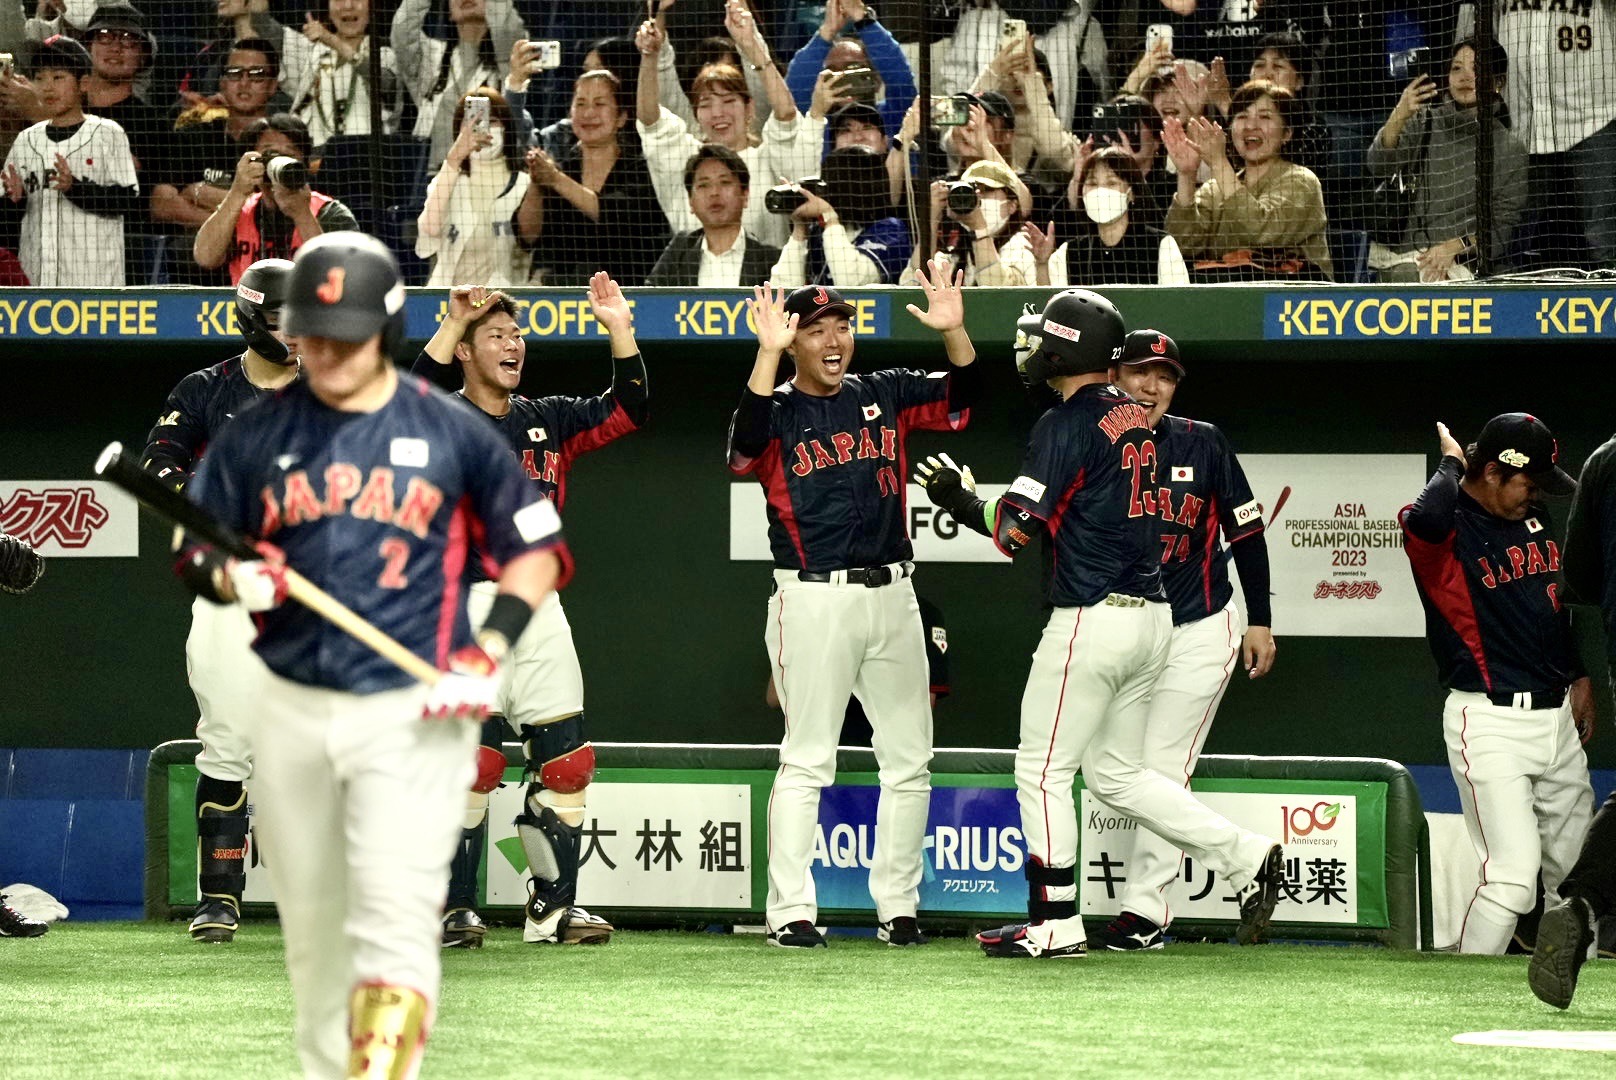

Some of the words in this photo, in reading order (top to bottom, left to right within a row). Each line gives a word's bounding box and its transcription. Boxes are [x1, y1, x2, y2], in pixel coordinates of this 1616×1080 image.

[1557, 24, 1593, 52] 89
[316, 266, 346, 305] J
[813, 286, 830, 306] J
[1150, 335, 1168, 355] J
[791, 425, 897, 478] JAPAN
[1121, 439, 1158, 519] 23
[0, 487, 110, 549] クスト
[1333, 503, 1368, 518] ASIA
[1285, 519, 1361, 531] PROFESSIONAL
[1363, 520, 1404, 531] BASEBA
[1160, 534, 1190, 564] 74
[1331, 550, 1368, 567] 2023
[377, 538, 412, 590] 2
[1314, 580, 1382, 599] カーネクスト
[1280, 801, 1337, 845] 100
[578, 818, 746, 872] 大林組
[1290, 836, 1338, 848] Anniversary
[533, 898, 548, 914] 31
